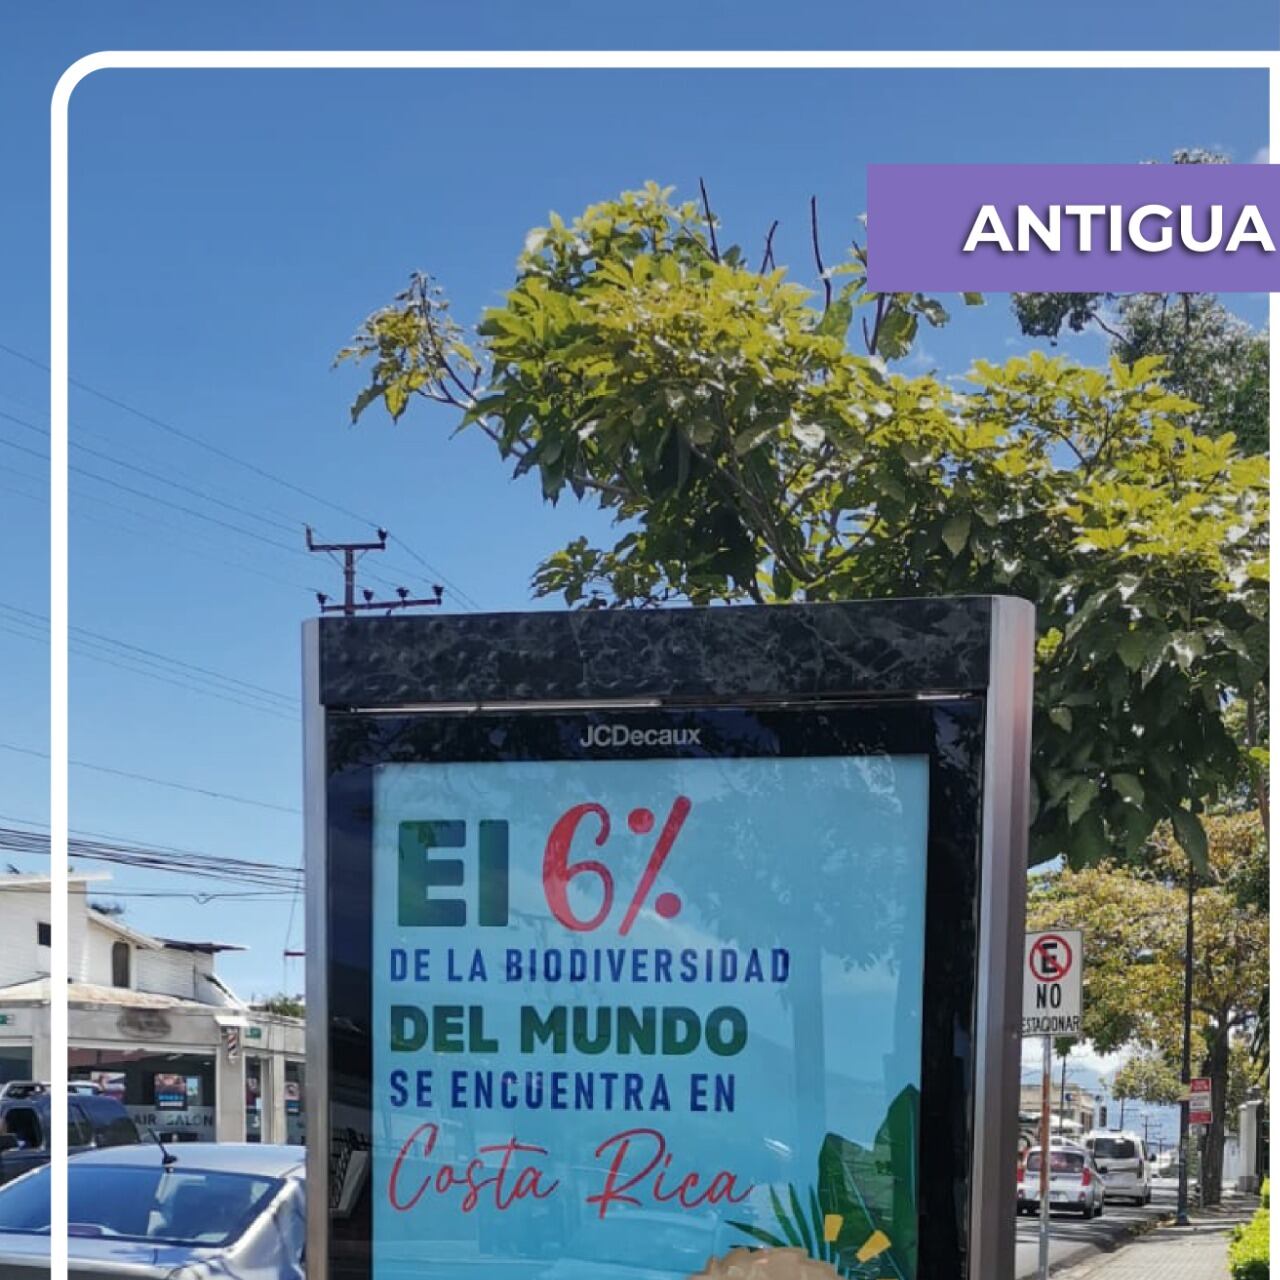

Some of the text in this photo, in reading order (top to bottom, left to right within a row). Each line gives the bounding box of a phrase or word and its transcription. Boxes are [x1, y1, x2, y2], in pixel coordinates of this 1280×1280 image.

[580, 726, 701, 749] JCDecaux
[397, 795, 692, 937] El 6%
[390, 948, 790, 984] DE LA BIODIVERSIDAD
[1042, 942, 1057, 973] E
[1036, 983, 1062, 1009] NO
[390, 1004, 749, 1058] DEL MUNDO
[389, 1069, 736, 1113] SE ENCUENTRA EN
[133, 1113, 157, 1126] AIR
[387, 1123, 755, 1221] Costa Rica
